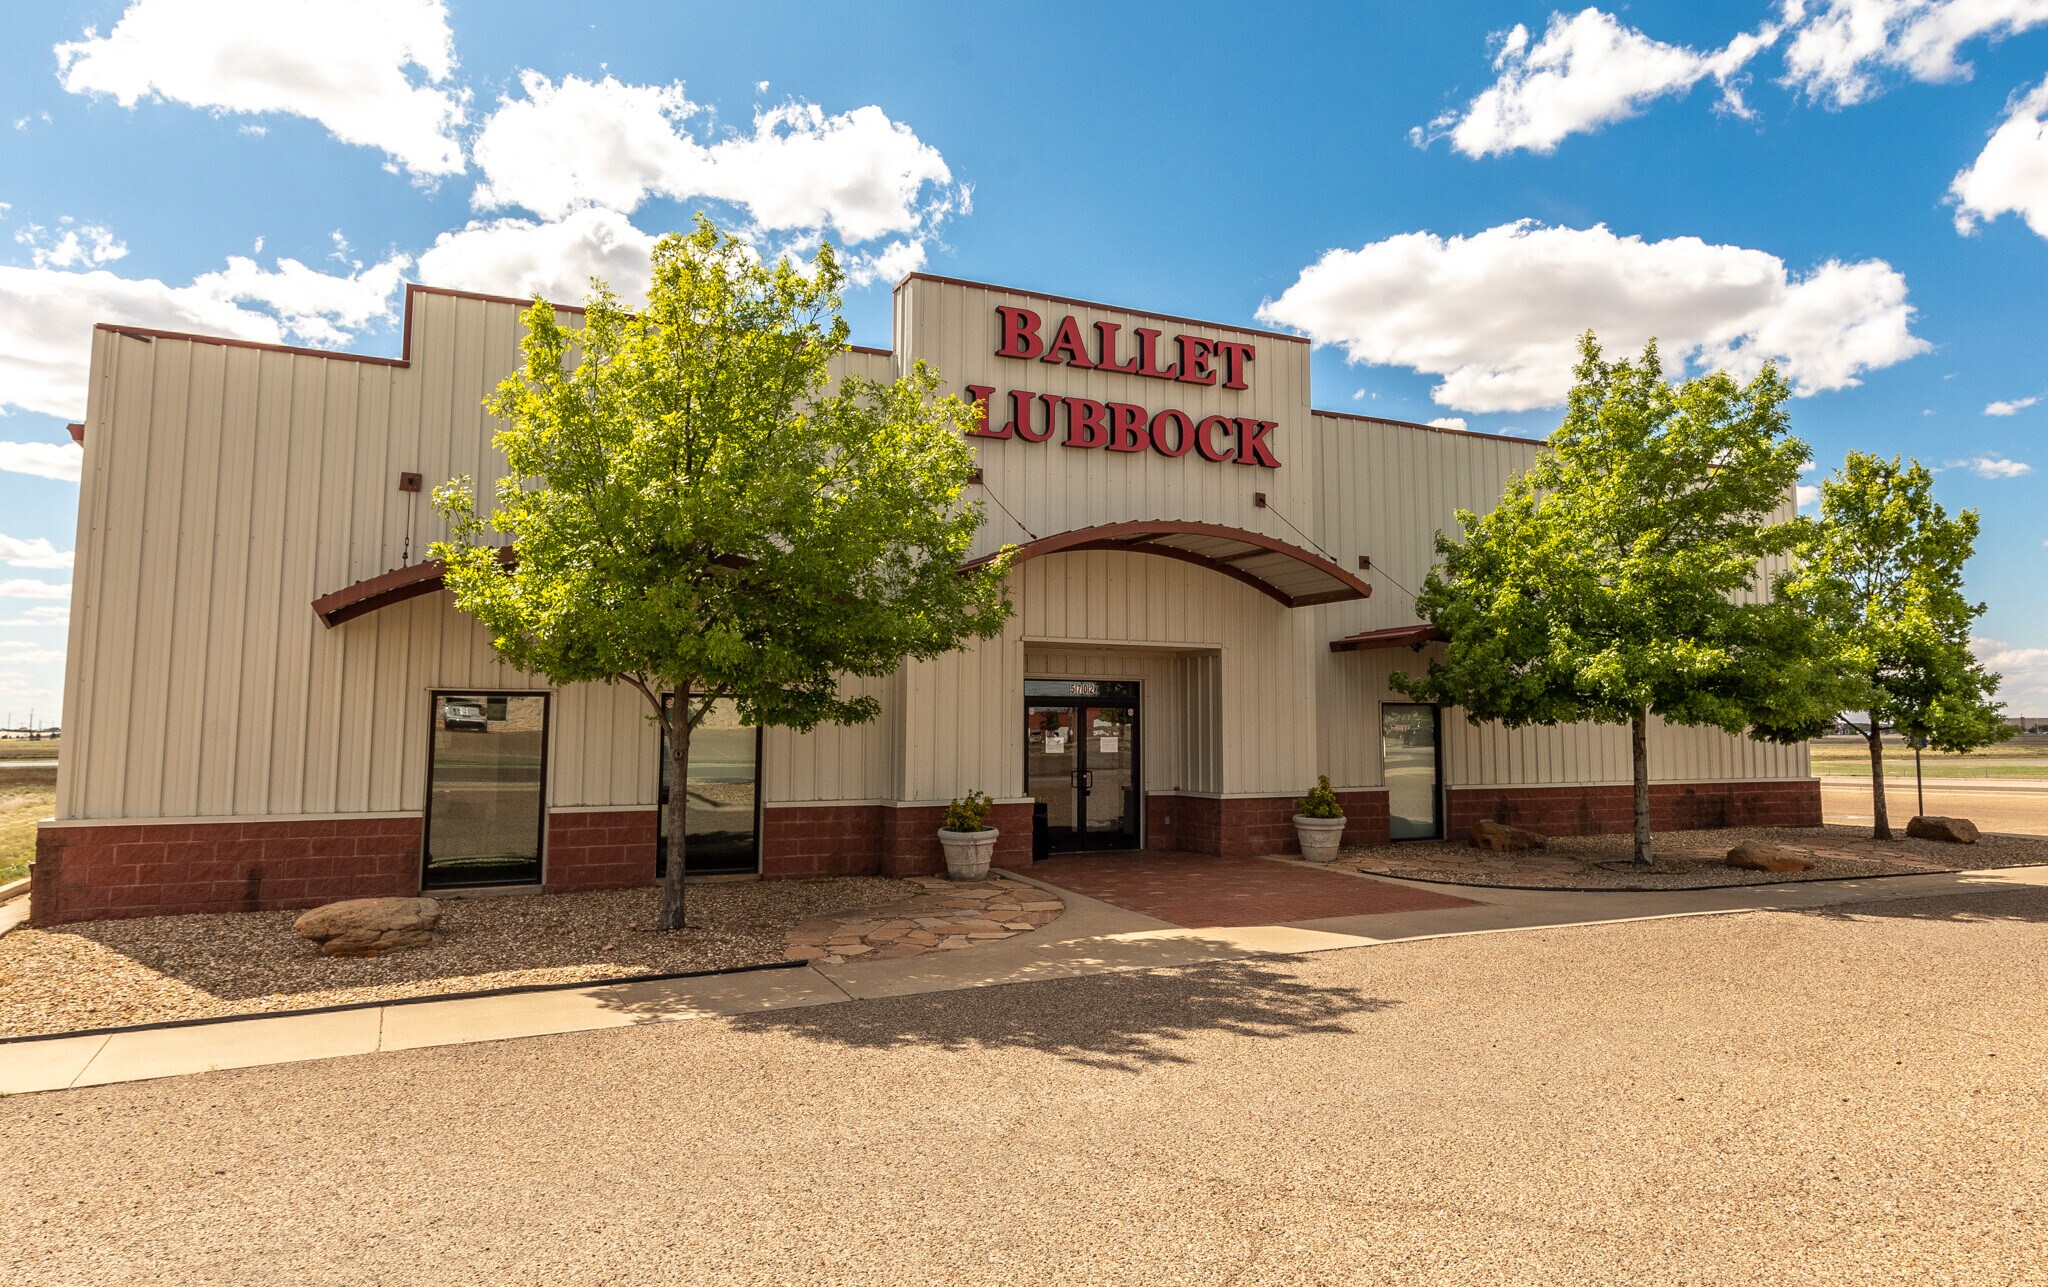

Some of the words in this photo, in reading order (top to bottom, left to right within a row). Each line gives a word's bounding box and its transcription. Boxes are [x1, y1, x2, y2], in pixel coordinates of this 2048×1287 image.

[995, 305, 1255, 391] BALLET
[964, 384, 1282, 469] LUBBOCK
[1070, 684, 1095, 694] 5702
